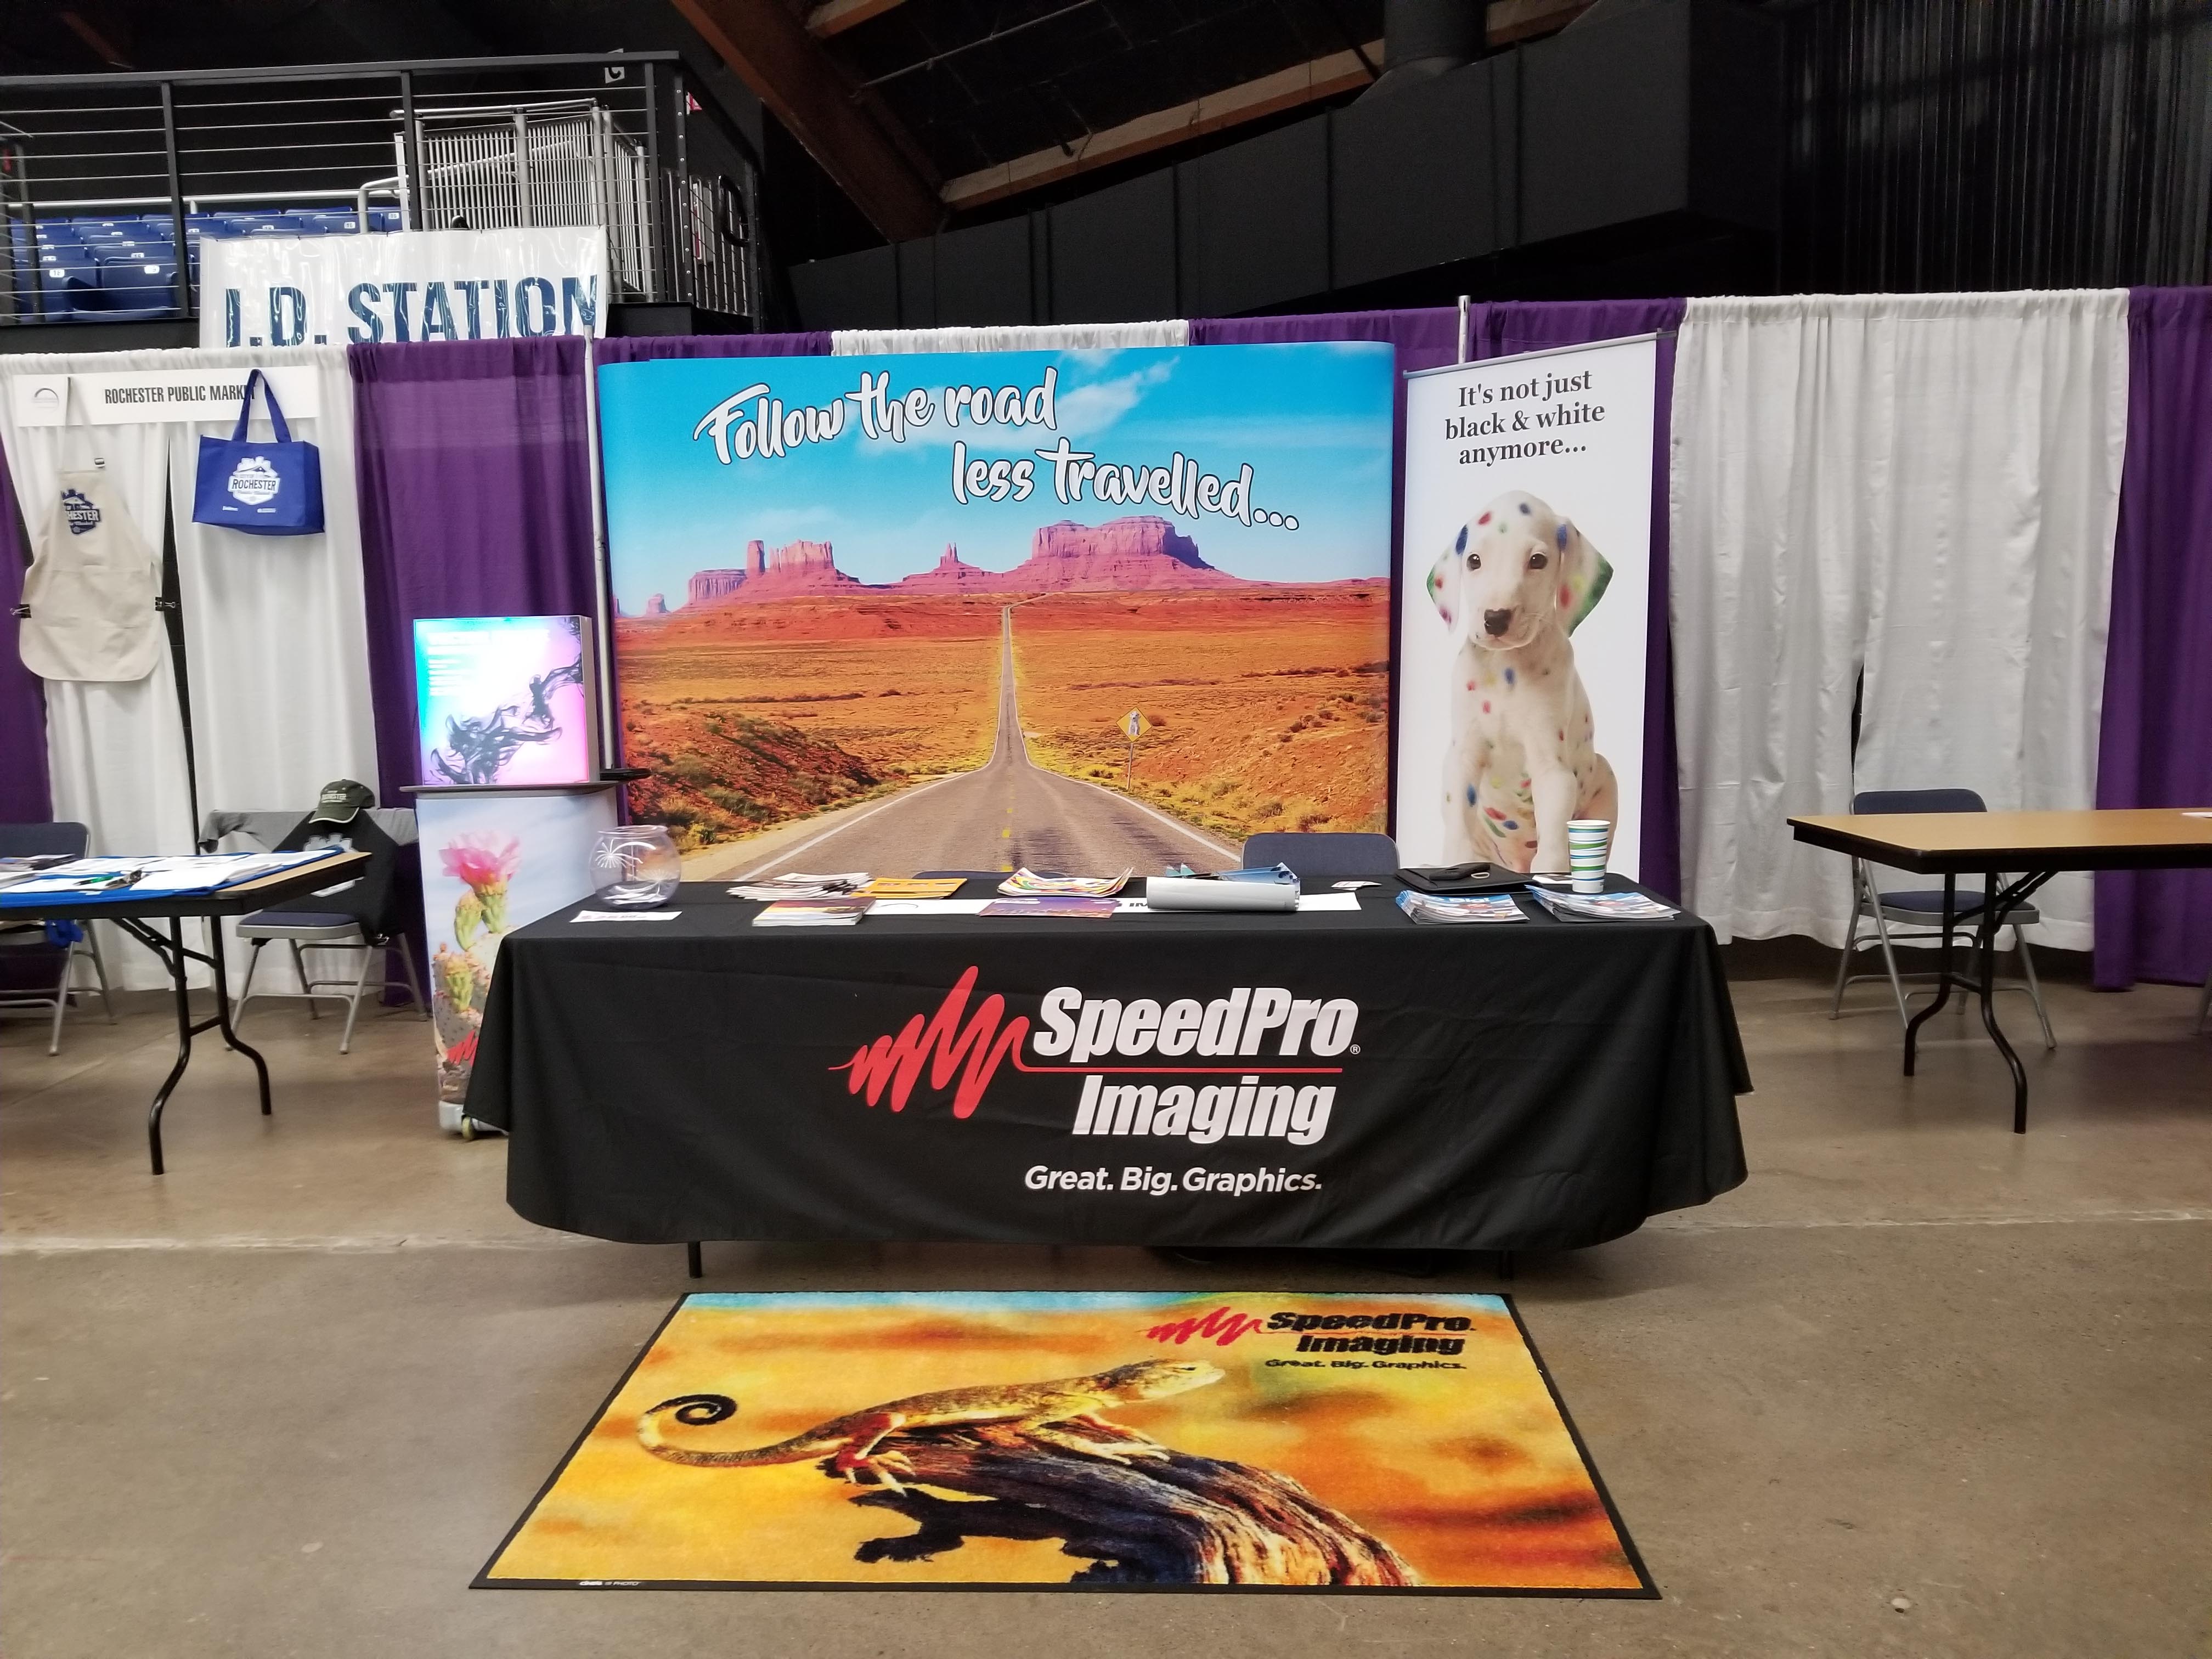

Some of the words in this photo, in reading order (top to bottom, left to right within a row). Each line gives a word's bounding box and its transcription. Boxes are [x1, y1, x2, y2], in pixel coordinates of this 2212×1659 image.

[225, 286, 328, 347] I.D.
[347, 274, 597, 344] STATION
[105, 387, 164, 404] ROCHESTER
[168, 386, 206, 402] PUBLIC
[1458, 383, 1493, 407] It's
[1500, 379, 1539, 402] not
[1542, 370, 1593, 401] just
[693, 382, 845, 464] Follow
[845, 370, 935, 443] the
[944, 365, 1057, 430] road
[1445, 413, 1506, 440] black
[1512, 410, 1530, 431] &
[1536, 402, 1605, 428] white
[1459, 438, 1587, 467] anymore...
[232, 479, 276, 490] ROCHESTER
[952, 441, 1035, 505] less
[1035, 437, 1299, 531] travelled...
[1071, 1075, 1336, 1146] Imaging
[1024, 1166, 1114, 1192] Great.
[1120, 1166, 1178, 1196] Big.
[1182, 1167, 1322, 1197] Graphics.
[1296, 1334, 1466, 1355] Imaging
[1265, 1359, 1325, 1368] Great.
[1372, 1359, 1467, 1370] Graphics.
